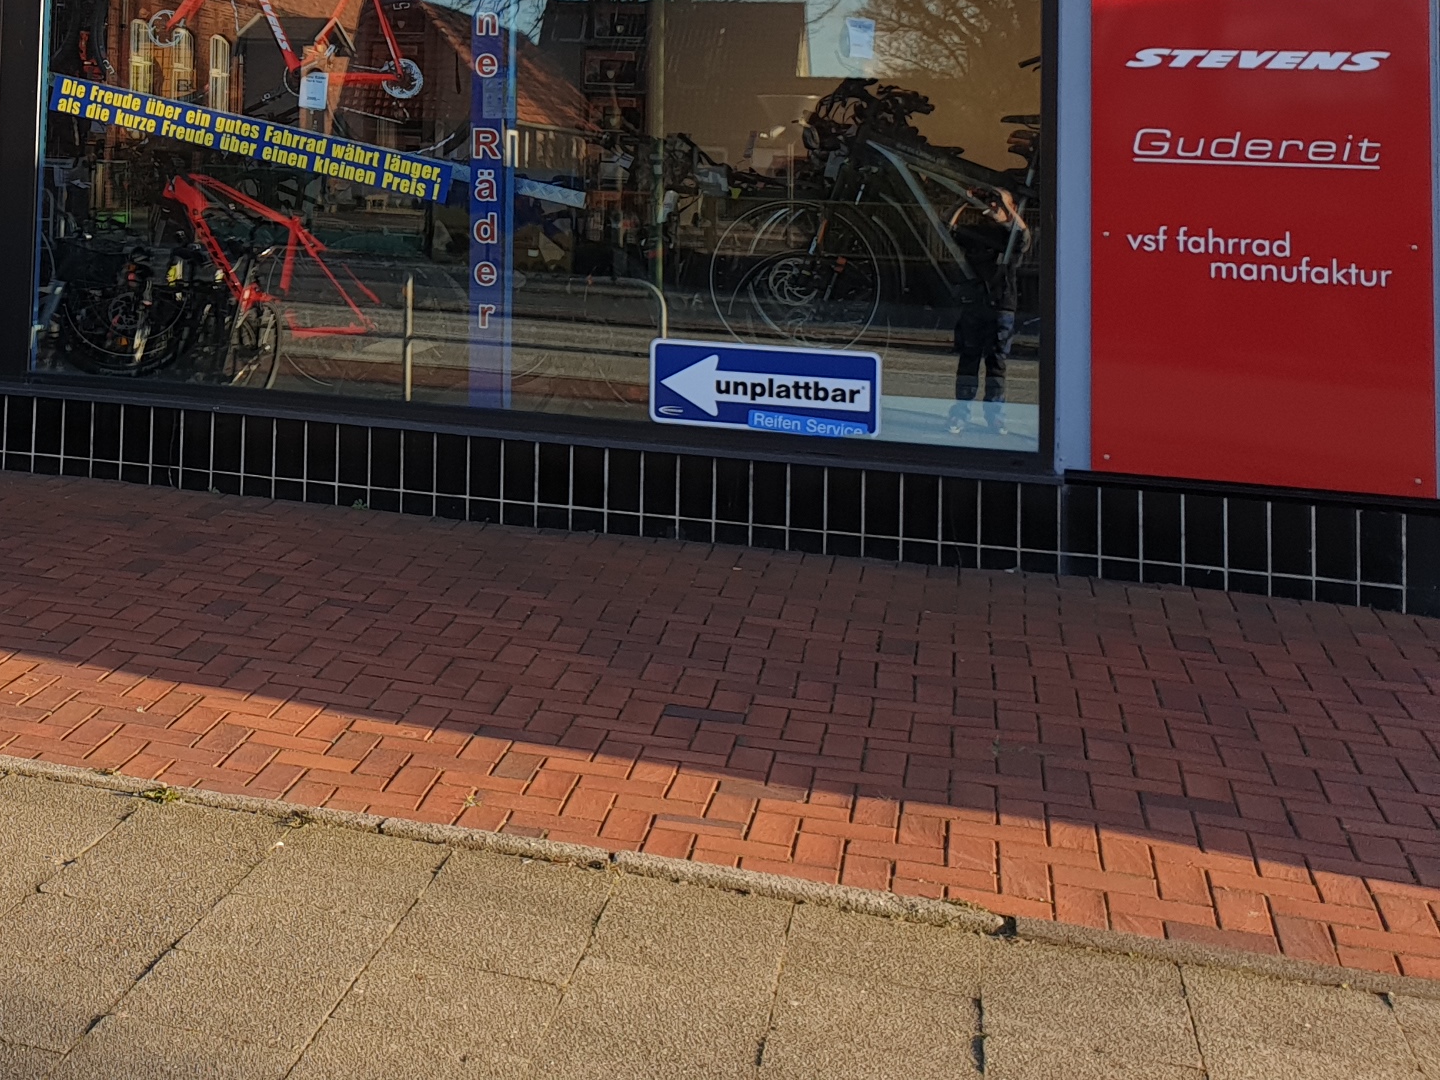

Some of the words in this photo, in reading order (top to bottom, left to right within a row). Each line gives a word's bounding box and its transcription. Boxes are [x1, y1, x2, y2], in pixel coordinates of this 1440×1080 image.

[1124, 47, 1391, 72] STEVENS
[61, 78, 86, 99] Die
[89, 85, 142, 112] Freude
[145, 98, 183, 121] über
[185, 109, 211, 128] ein
[214, 116, 261, 139] gutes
[263, 124, 328, 156] Fahrrad
[331, 142, 380, 168] währt
[383, 153, 442, 183] länger,
[1131, 126, 1383, 165] Gudereit
[57, 97, 81, 116] als
[85, 102, 110, 122] die
[114, 108, 157, 133] kurze
[161, 120, 215, 147] Freude
[219, 134, 259, 157] über
[262, 145, 309, 170] einen
[312, 155, 377, 187] kleinen
[381, 172, 427, 198] Preis
[431, 184, 441, 201] !
[471, 127, 502, 330] Räder
[1126, 225, 1167, 253] vsf
[1176, 226, 1291, 259] fahrrad
[1209, 259, 1393, 288] manufaktur
[714, 377, 861, 404] unplattbar
[752, 411, 802, 431] Reifen
[805, 418, 864, 435] Service
